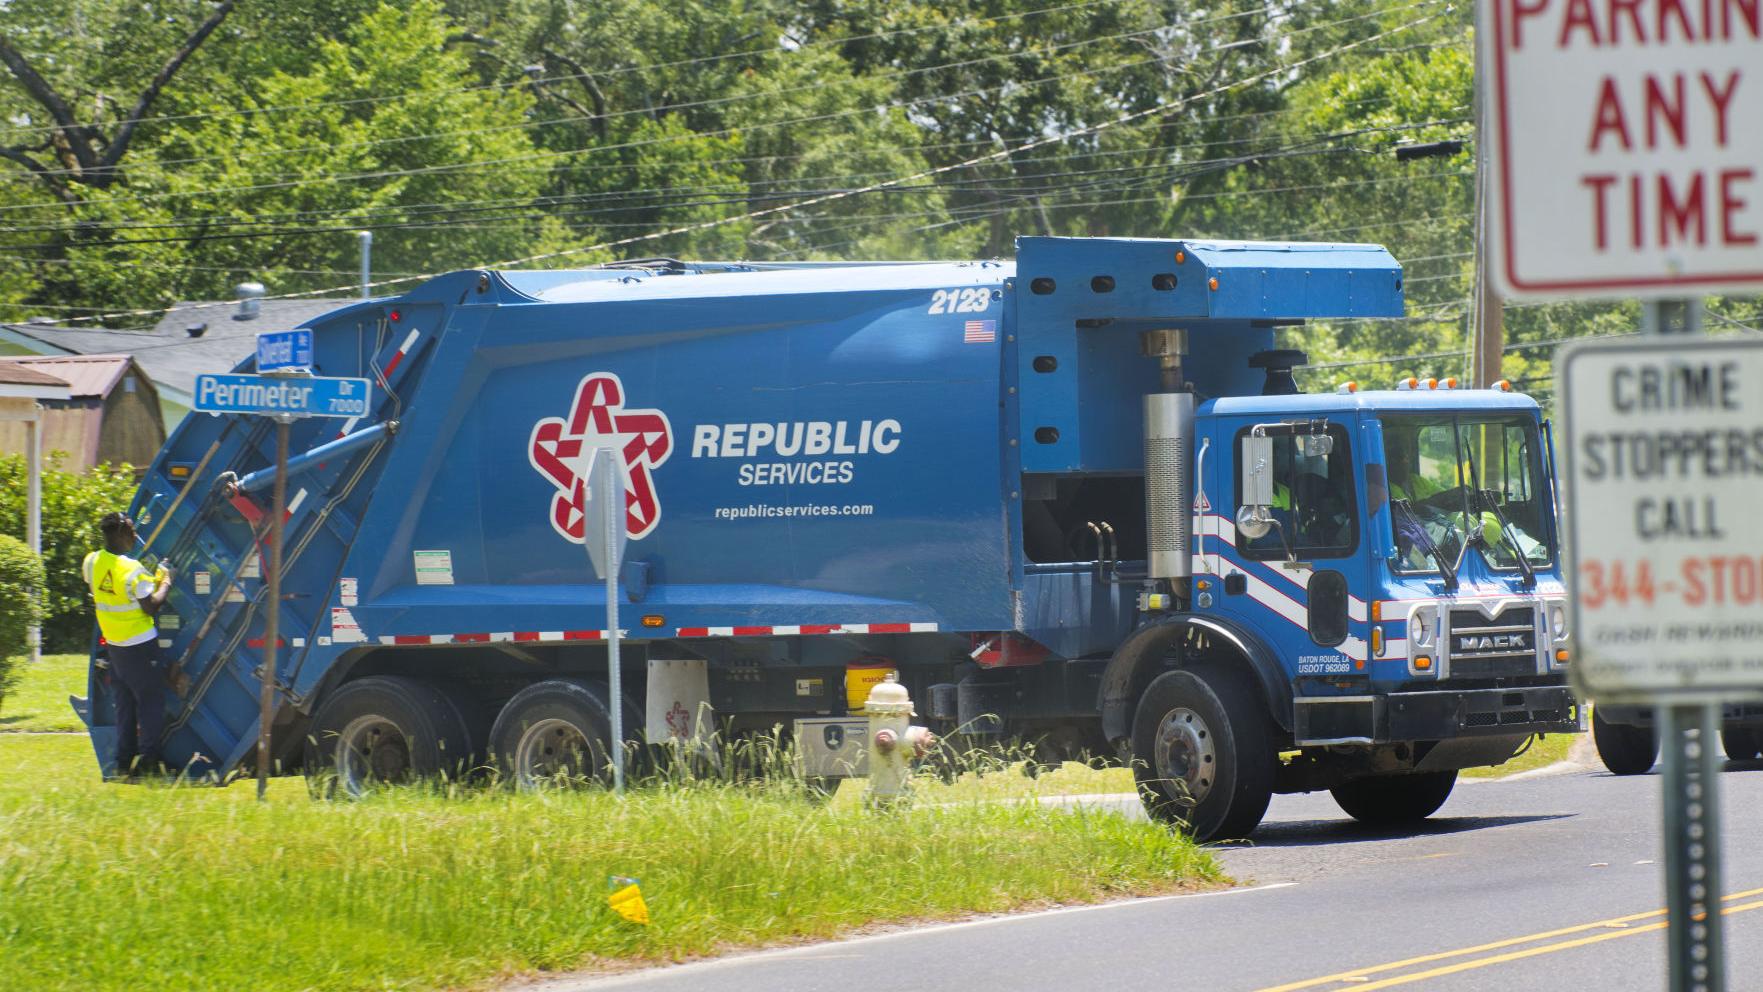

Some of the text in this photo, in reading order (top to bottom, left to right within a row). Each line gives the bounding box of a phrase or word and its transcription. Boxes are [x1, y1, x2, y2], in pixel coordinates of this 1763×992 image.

[1588, 70, 1741, 153] ANY
[1580, 168, 1758, 253] TIME
[928, 287, 991, 315] 2123
[199, 377, 354, 409] Perimeter Dr
[1611, 360, 1742, 414] CRIME
[328, 398, 364, 413] 7000
[691, 418, 902, 458] REPUBLIC
[738, 461, 854, 486] SERVICES
[715, 503, 873, 521] republicservices.com
[1633, 495, 1727, 542] CALL
[1580, 554, 1763, 612] 344-STO
[1460, 634, 1525, 650] MACK
[1299, 663, 1350, 673] USDOT 962089
[1320, 655, 1340, 664] ROUGE,
